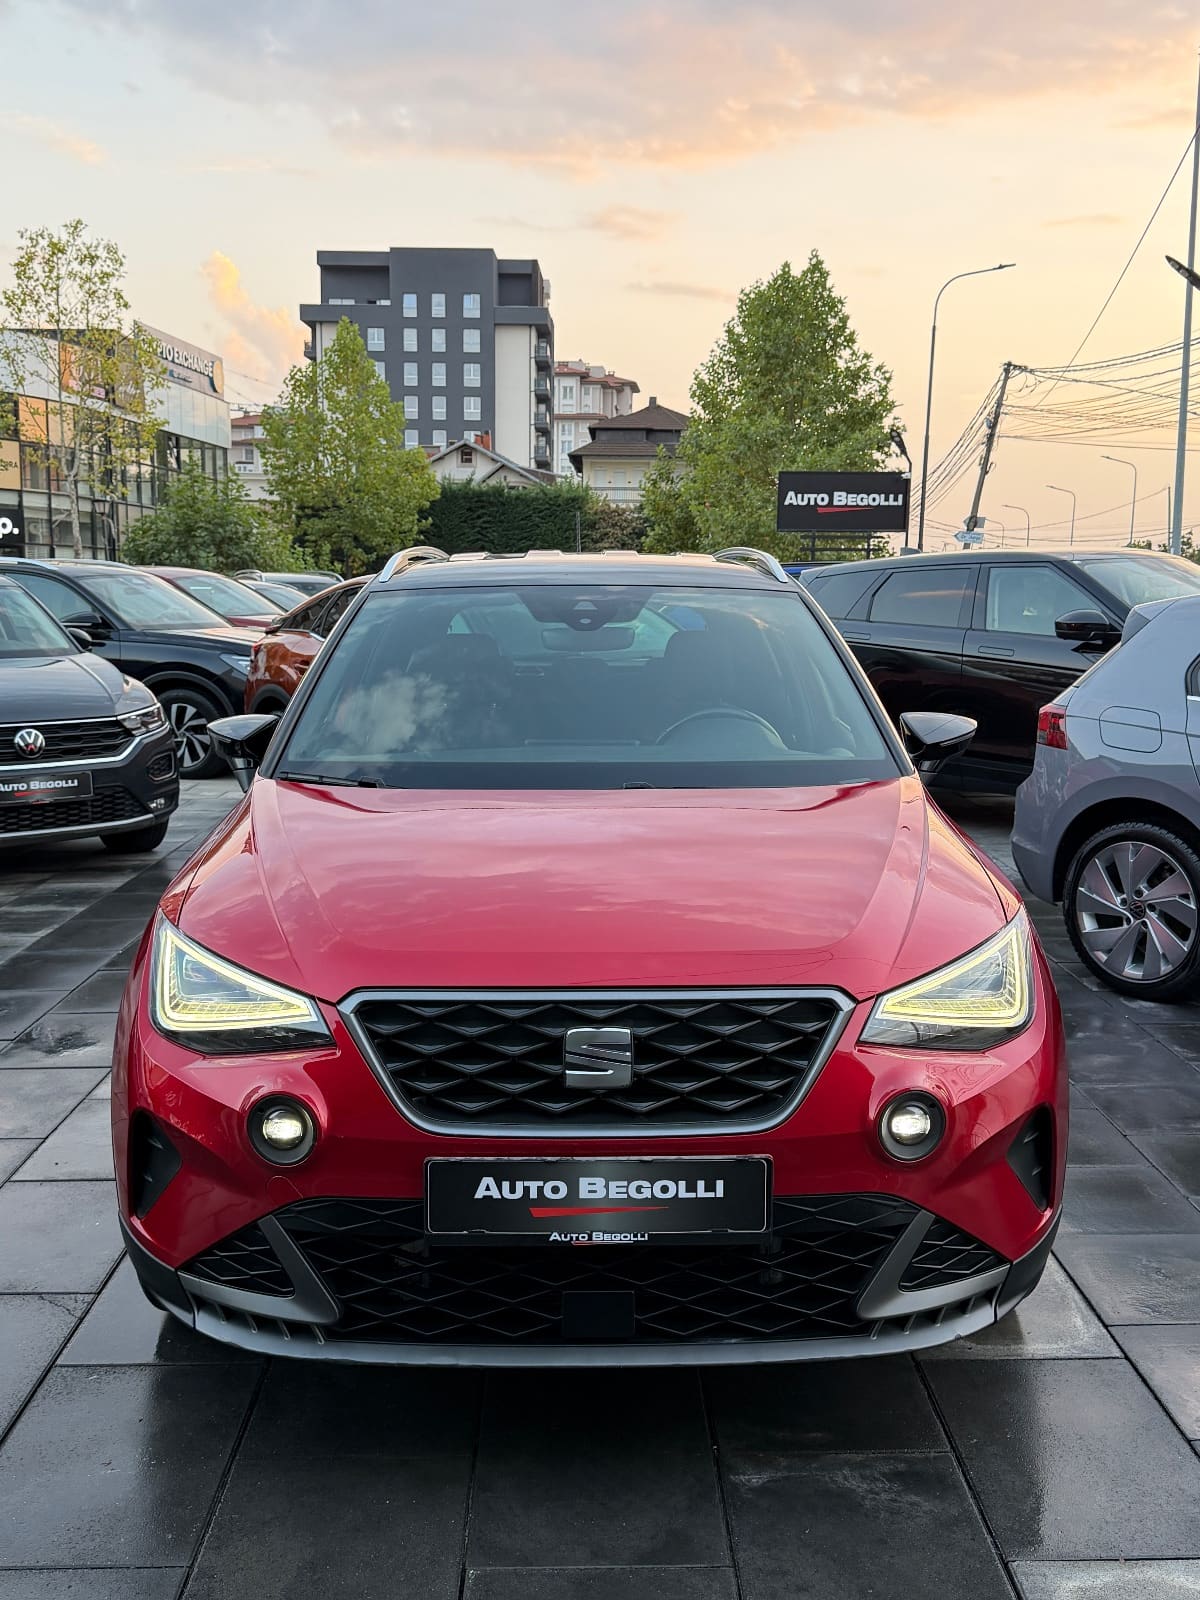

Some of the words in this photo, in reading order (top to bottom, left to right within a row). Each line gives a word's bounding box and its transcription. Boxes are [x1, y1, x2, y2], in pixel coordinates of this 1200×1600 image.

[174, 347, 213, 377] EXCHANGE
[784, 491, 829, 506] AUTO
[833, 491, 903, 506] BEGOLLI
[29, 779, 79, 790] BEGOLLI
[474, 1176, 568, 1200] AUTO
[578, 1177, 724, 1199] BEGOLLI
[549, 1232, 588, 1241] AUTO
[592, 1232, 648, 1241] BEGOLLI
